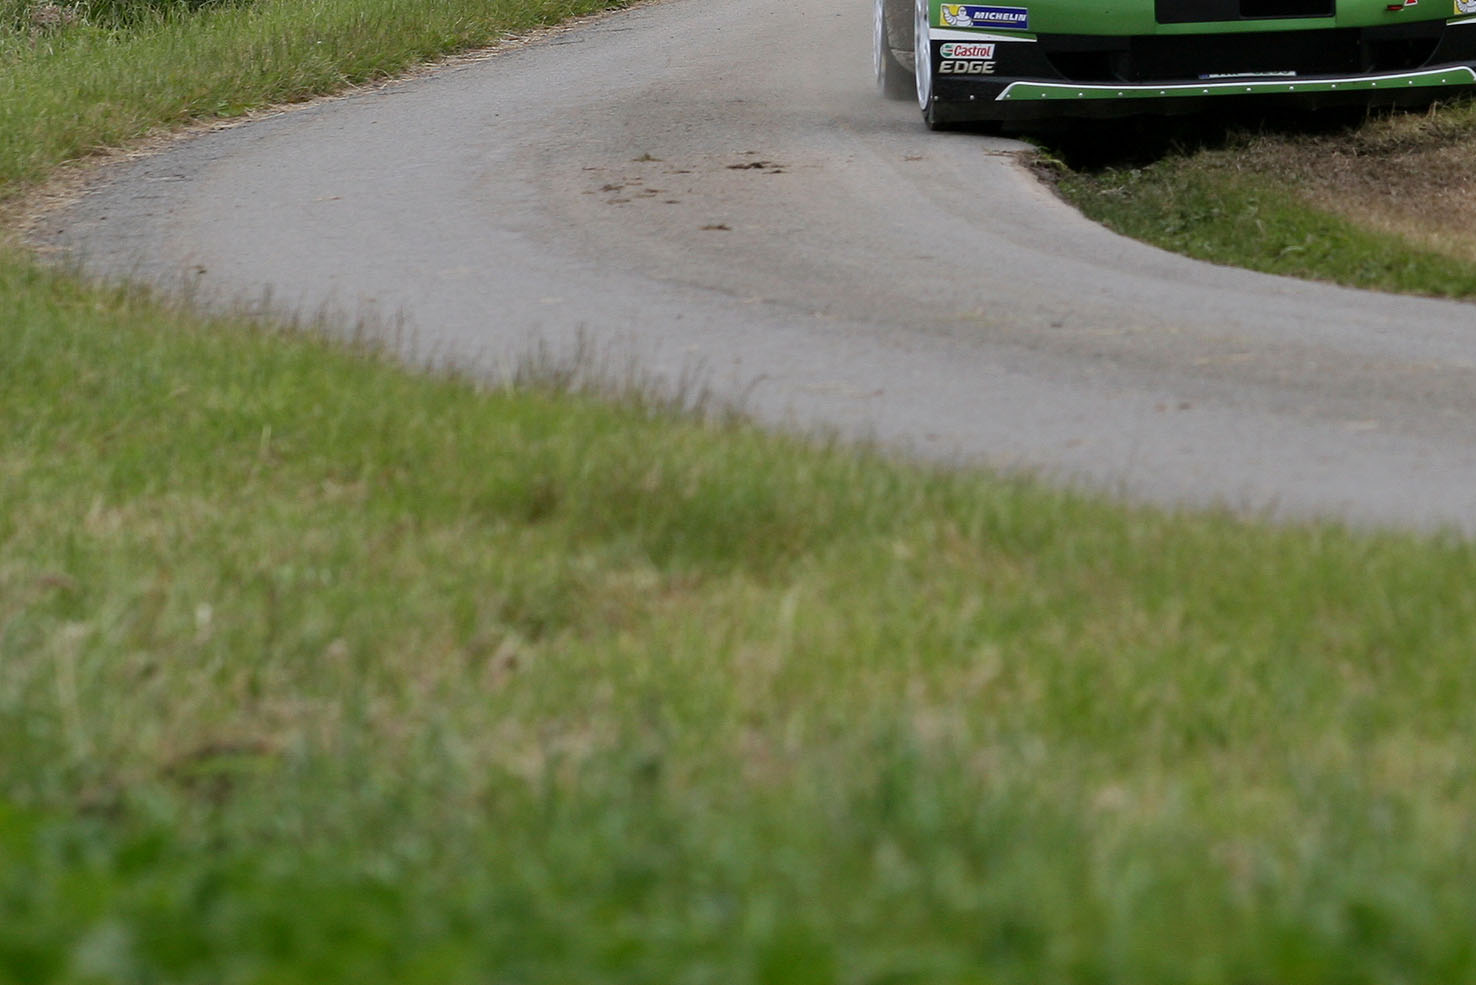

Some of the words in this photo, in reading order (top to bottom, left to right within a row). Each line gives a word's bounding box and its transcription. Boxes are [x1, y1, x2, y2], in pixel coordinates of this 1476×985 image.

[973, 11, 1028, 22] MICHELIN
[954, 45, 991, 57] Castrol
[938, 60, 997, 74] EDGE
